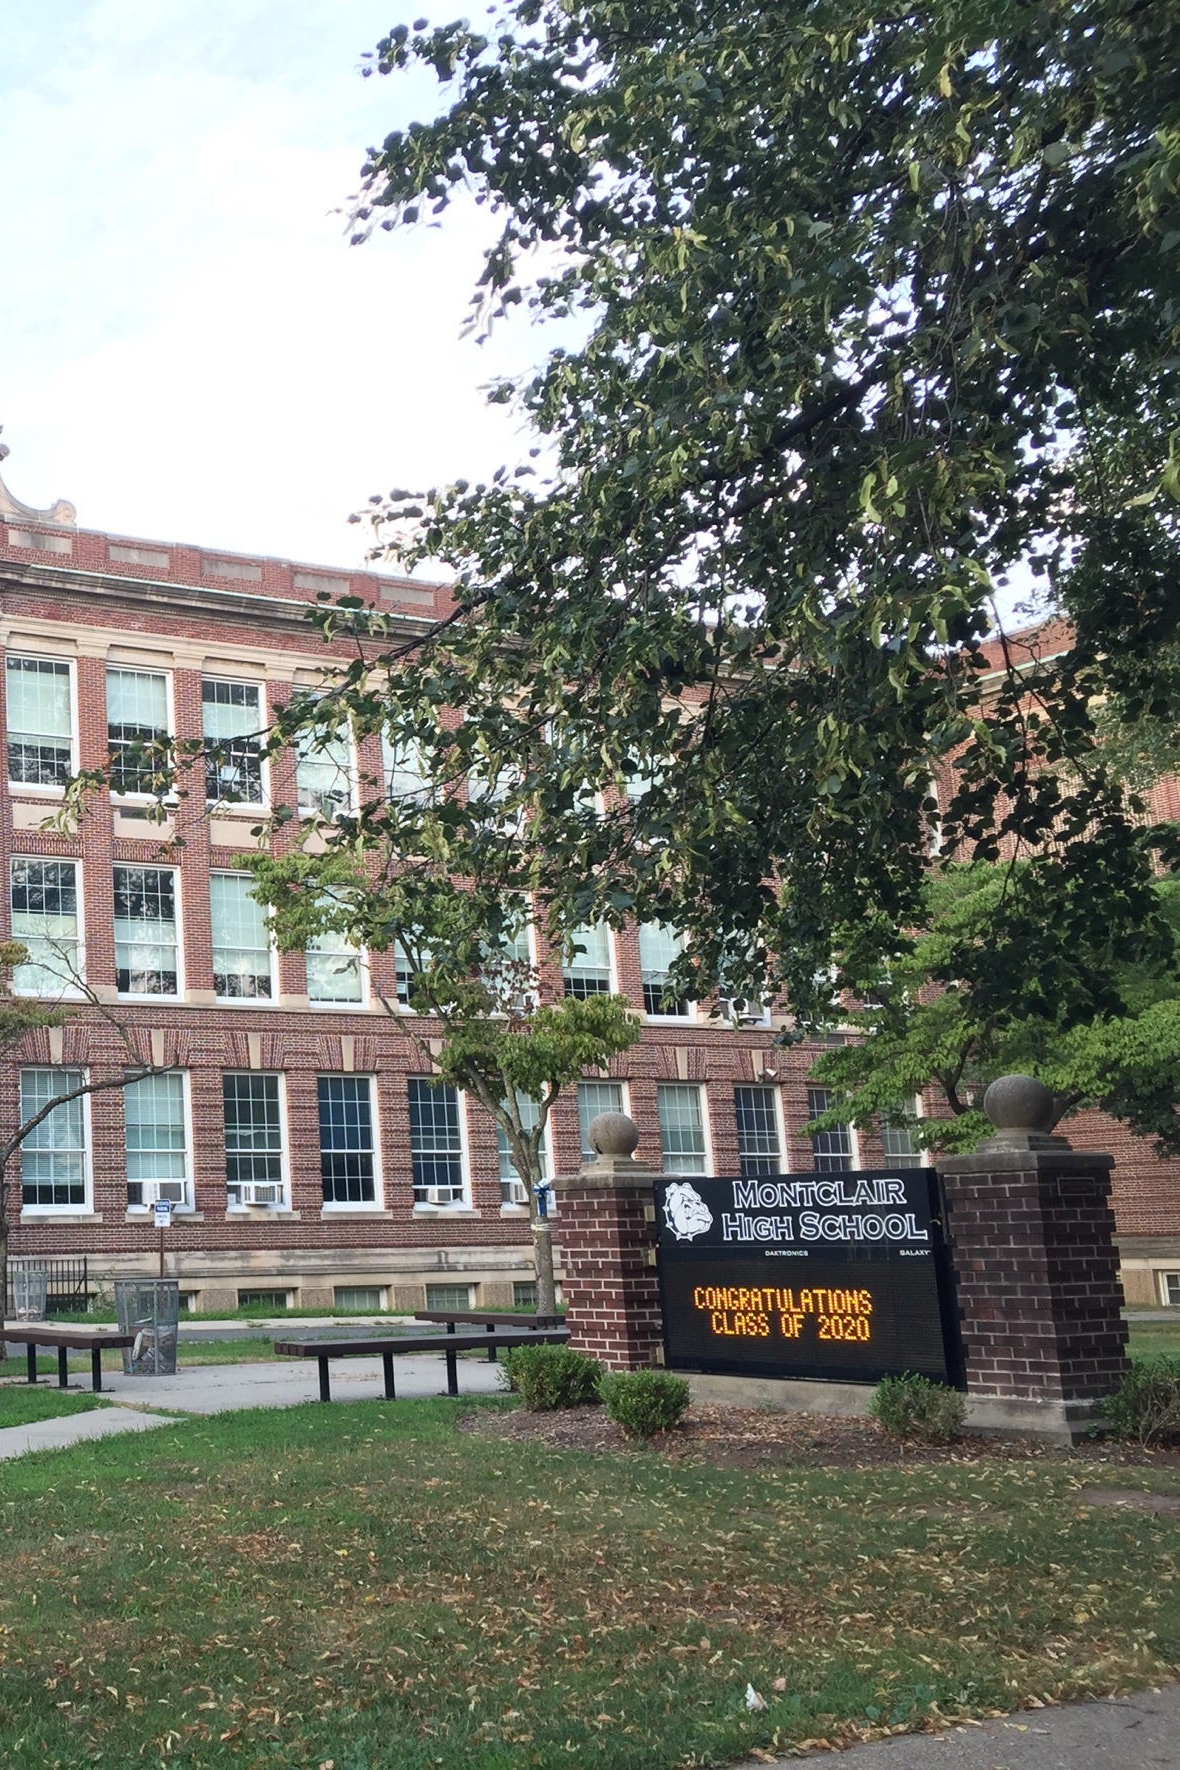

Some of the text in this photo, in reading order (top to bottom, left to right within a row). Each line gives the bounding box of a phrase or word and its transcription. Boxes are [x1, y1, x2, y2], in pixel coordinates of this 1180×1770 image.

[732, 1178, 907, 1209] MONTCLAIR
[721, 1211, 929, 1241] HIGH SCHOOL
[693, 1286, 876, 1315] CONGRATULATIONS
[711, 1311, 871, 1341] CLASS OF 2020
